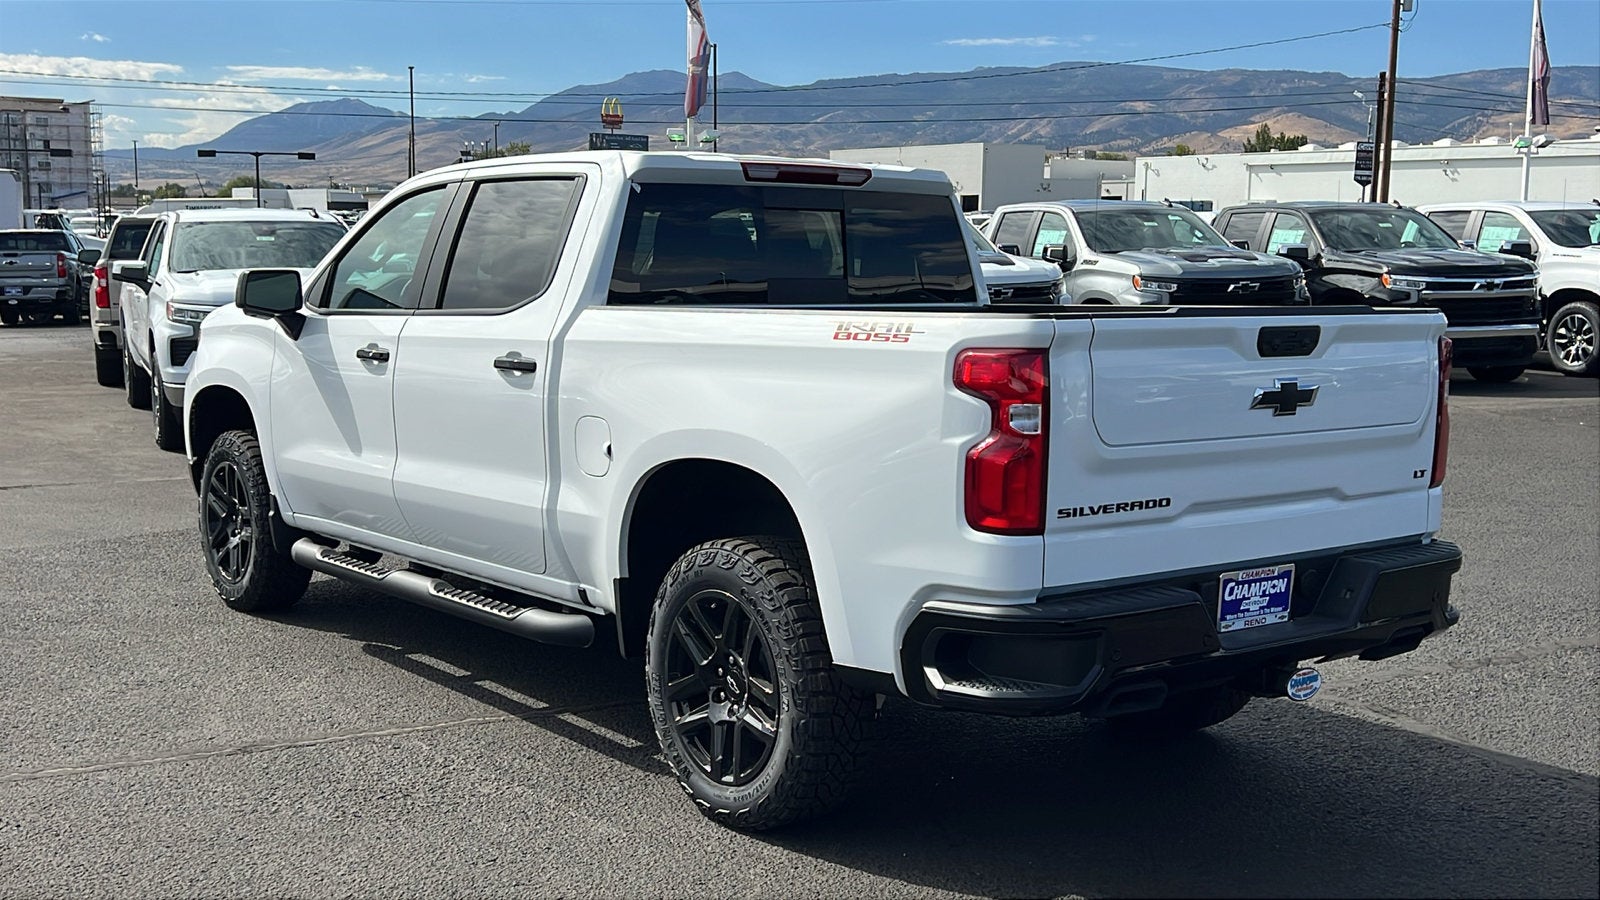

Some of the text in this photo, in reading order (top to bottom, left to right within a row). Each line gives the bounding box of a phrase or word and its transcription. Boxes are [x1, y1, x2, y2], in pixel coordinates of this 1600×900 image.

[833, 331, 911, 343] BOSS
[1413, 469, 1428, 479] LT
[1057, 497, 1171, 519] SILVERADO
[1241, 568, 1276, 580] CHAMPION
[1224, 578, 1288, 601] CHAMPION
[1244, 617, 1268, 628] RENO
